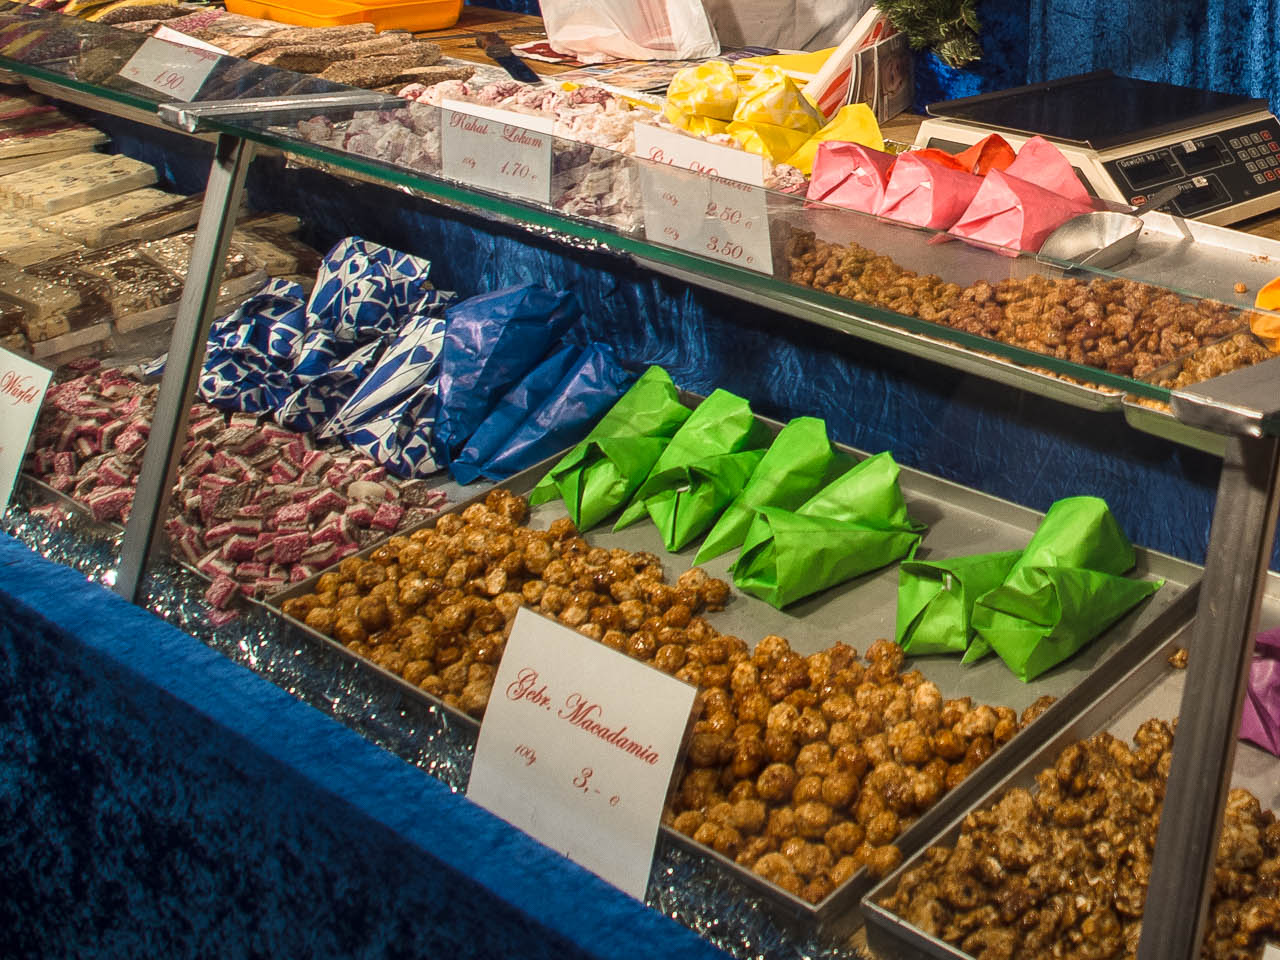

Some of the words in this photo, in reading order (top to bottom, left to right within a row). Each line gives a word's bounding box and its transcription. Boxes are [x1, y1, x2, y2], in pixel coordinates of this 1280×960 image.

[153, 71, 184, 90] 1.90
[449, 111, 489, 135] Rahat
[500, 124, 543, 148] Lokum
[500, 161, 530, 178] 1.70
[704, 201, 742, 225] 2.50
[706, 236, 744, 260] 3.50
[506, 667, 552, 710] Gebr.
[558, 693, 660, 765] Macadamia
[514, 743, 536, 766] 100g
